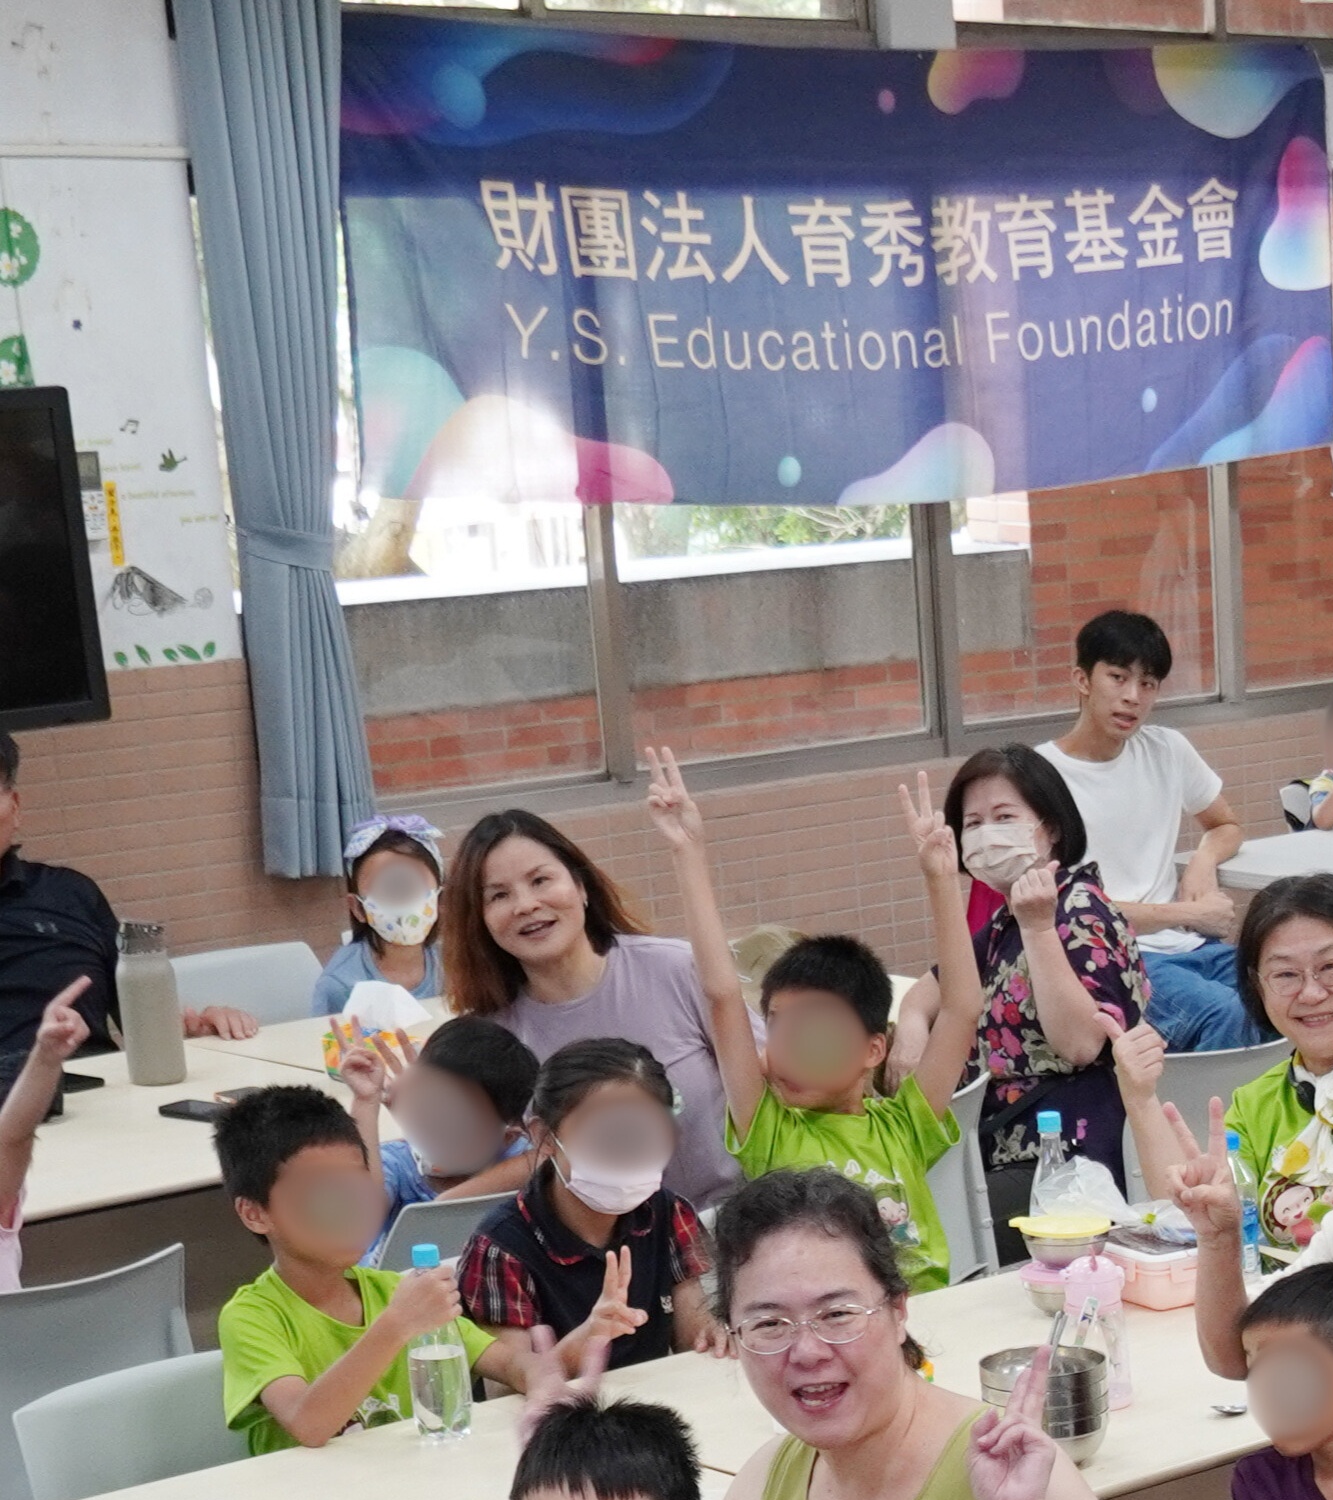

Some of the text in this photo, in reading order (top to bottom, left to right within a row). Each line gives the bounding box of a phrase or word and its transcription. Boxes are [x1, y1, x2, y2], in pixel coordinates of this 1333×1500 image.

[478, 176, 1239, 289] 財團法人育秀教育基金會
[505, 294, 1235, 374] Y.S. Educational Foundation
